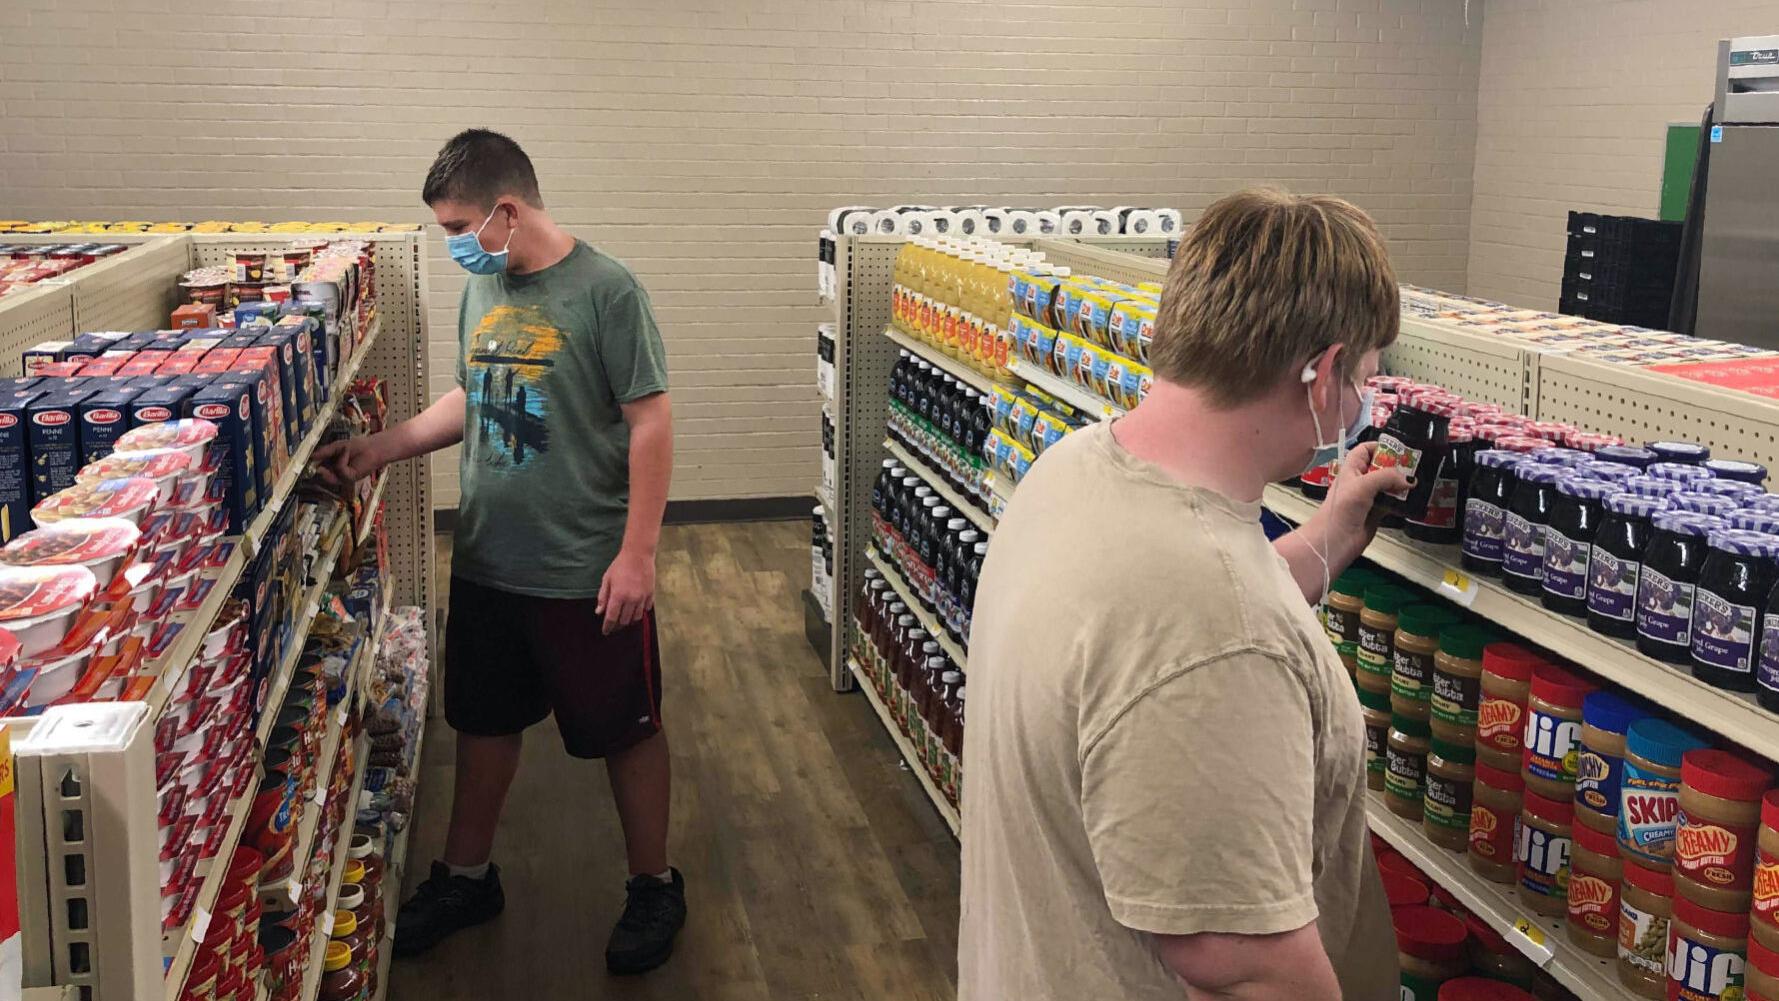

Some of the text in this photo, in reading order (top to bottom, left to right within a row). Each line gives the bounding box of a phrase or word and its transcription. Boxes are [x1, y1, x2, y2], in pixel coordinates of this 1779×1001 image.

[92, 411, 118, 420] Barilla
[143, 409, 169, 419] Barilla
[202, 405, 228, 416] Barilla
[41, 413, 68, 424] Barilla
[1647, 616, 1670, 629] Grape
[1704, 641, 1729, 655] Grape
[1480, 702, 1517, 726] REAMY
[1524, 711, 1581, 758] Jif
[1627, 795, 1679, 825] SKIP
[1643, 829, 1674, 841] CREAMY
[1678, 827, 1731, 857] CREAMY
[1519, 825, 1571, 874] Jif
[1681, 856, 1724, 870] PEANUT BUTTER
[1706, 869, 1732, 879] FRESH
[1568, 879, 1606, 904] REAMY
[1668, 937, 1745, 996] Jif
